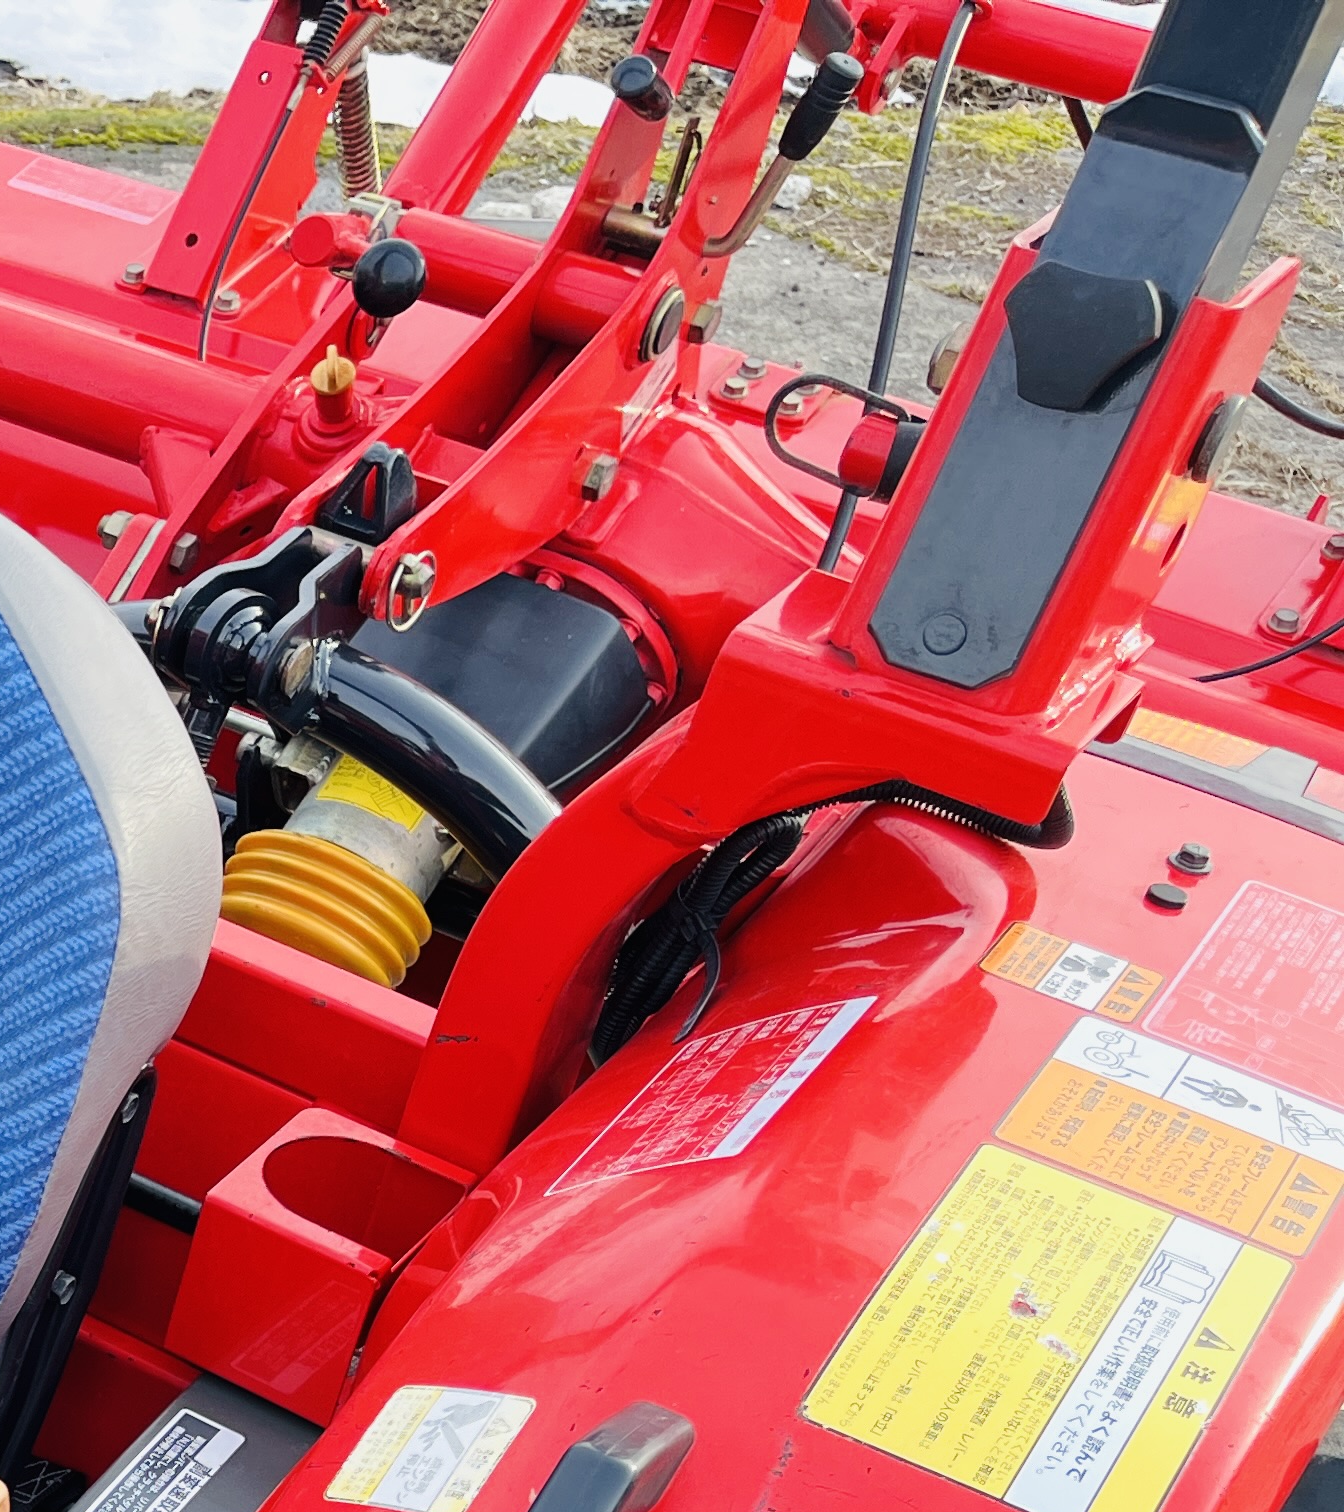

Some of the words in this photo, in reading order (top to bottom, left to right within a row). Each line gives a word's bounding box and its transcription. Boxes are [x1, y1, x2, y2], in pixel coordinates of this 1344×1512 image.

[1269, 1192, 1317, 1242] 警告
[1034, 1294, 1159, 1481] 安全で正しい作業をしてください。
[1062, 1304, 1182, 1484] 使用前に取扱説明書をよく読んで
[1160, 1359, 1217, 1420] 注意
[392, 1456, 433, 1503] エンジン
